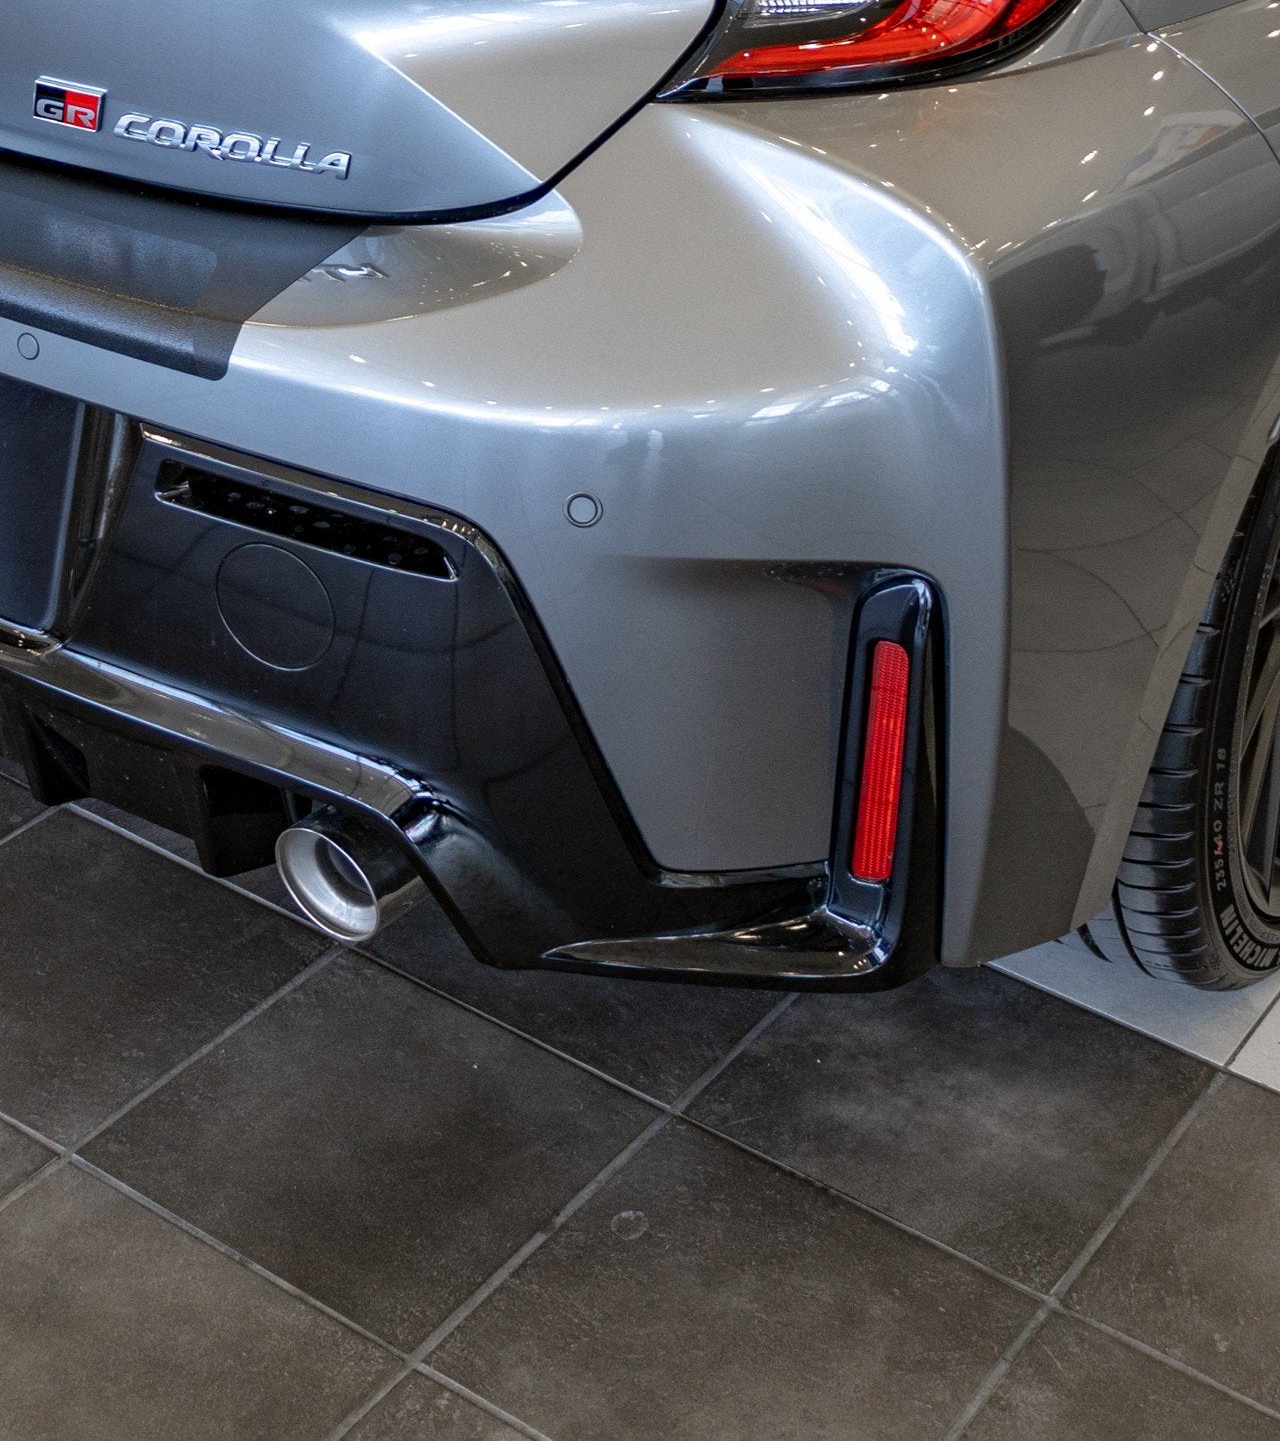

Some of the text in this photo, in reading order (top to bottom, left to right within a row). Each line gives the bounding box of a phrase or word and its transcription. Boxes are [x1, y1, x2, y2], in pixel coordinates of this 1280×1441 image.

[36, 98, 353, 182] GR COROLLA
[1220, 903, 1280, 969] MICHELIN
